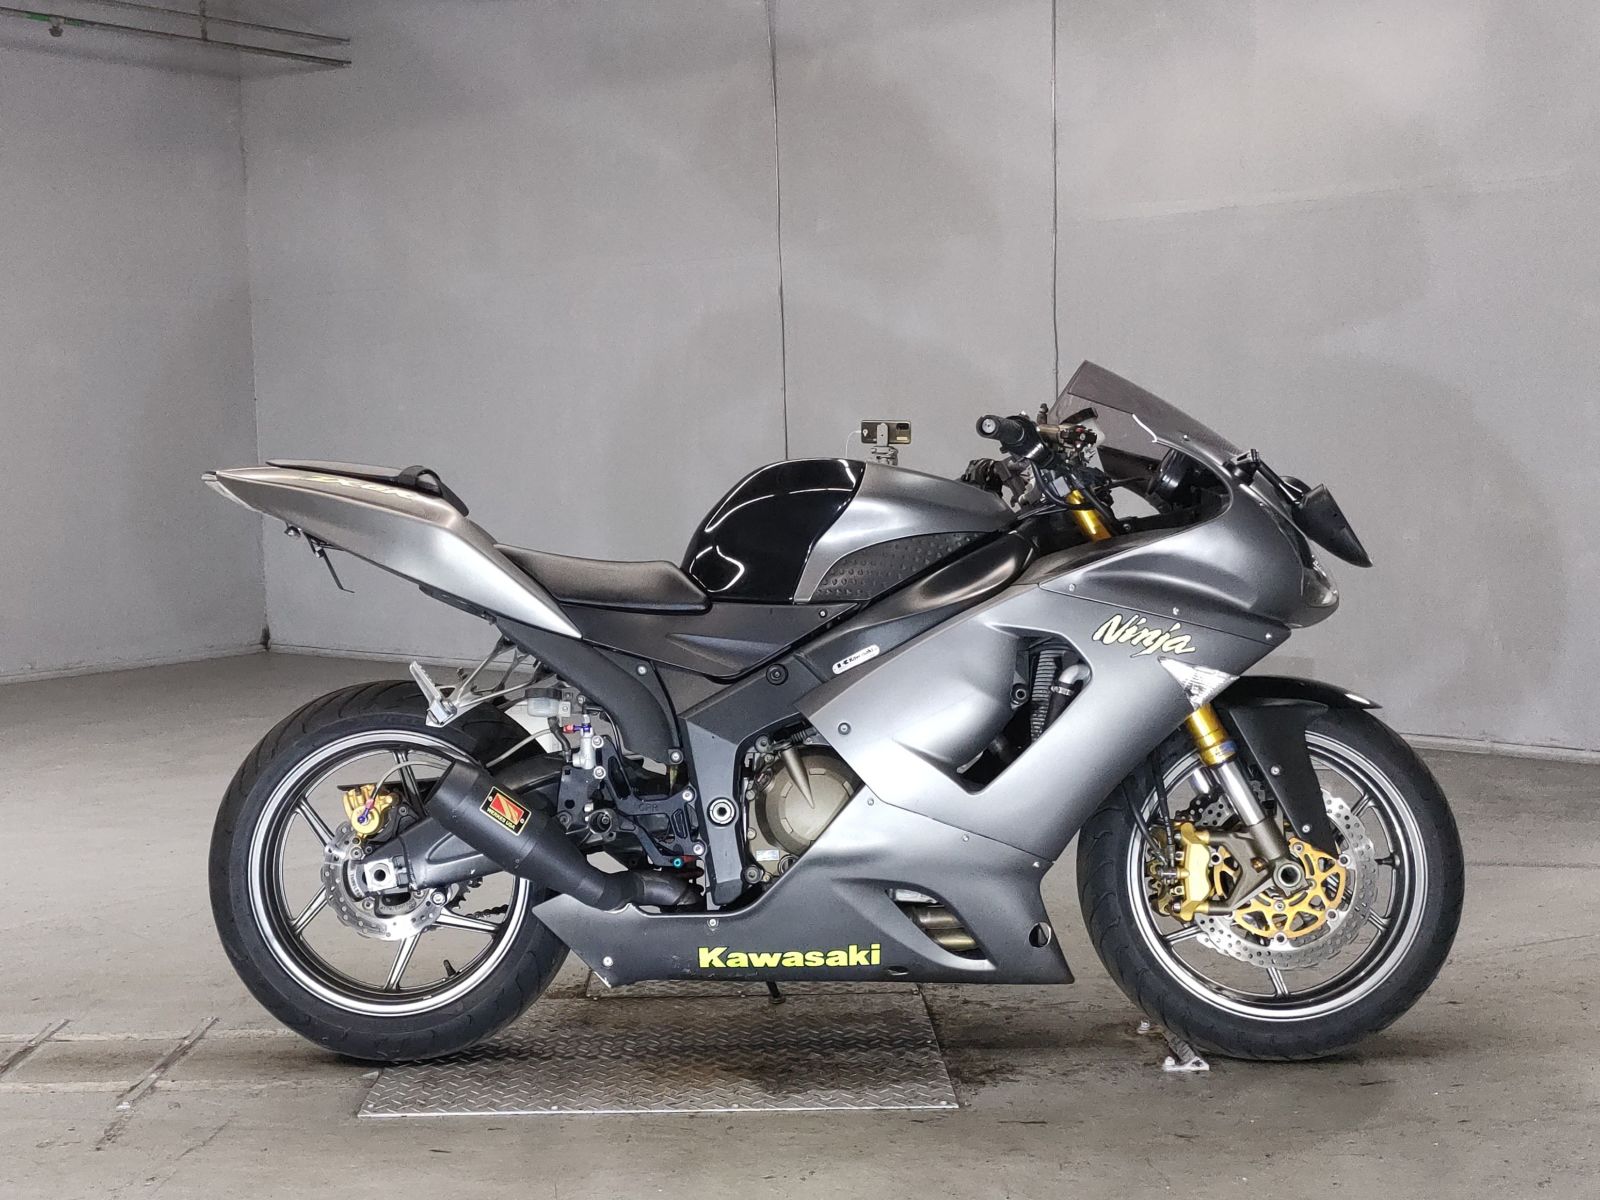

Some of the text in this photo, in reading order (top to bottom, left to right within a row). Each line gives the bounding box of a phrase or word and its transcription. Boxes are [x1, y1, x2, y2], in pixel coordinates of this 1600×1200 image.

[1092, 614, 1196, 658] Ninja
[505, 820, 516, 830] USA
[698, 943, 881, 967] Kawasaki
